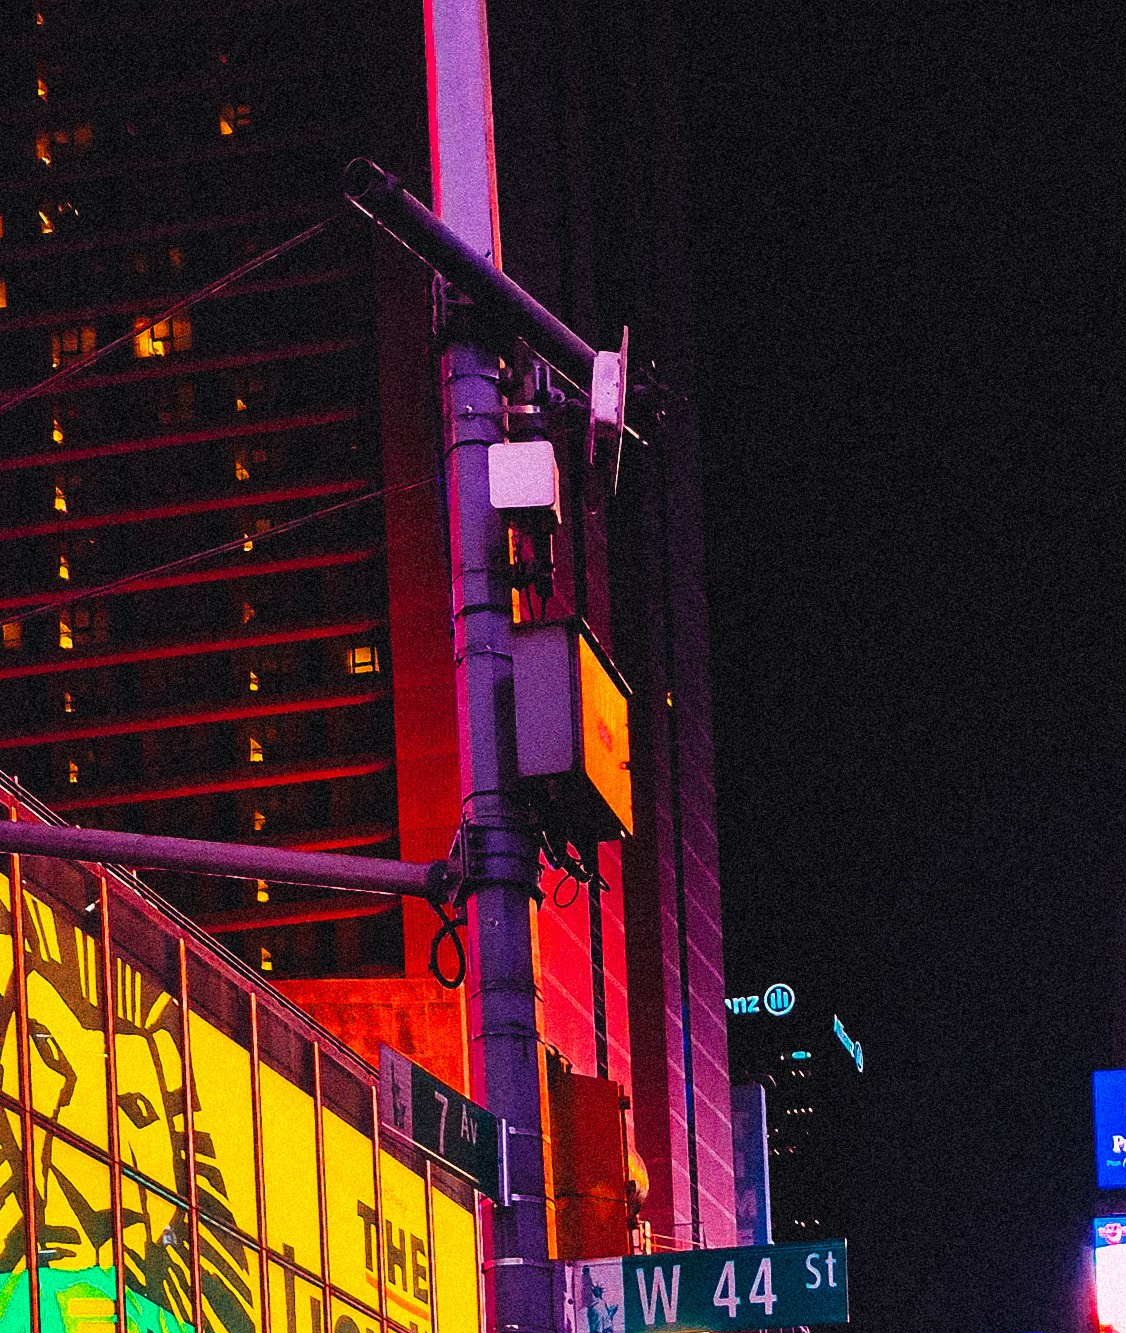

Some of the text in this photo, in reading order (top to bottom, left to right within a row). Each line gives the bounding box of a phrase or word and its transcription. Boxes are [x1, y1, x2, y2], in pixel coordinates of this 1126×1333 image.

[724, 995, 760, 1014] nz
[434, 1090, 478, 1156] 7 Av
[357, 1200, 429, 1304] THE
[636, 1251, 838, 1325] W 44 St
